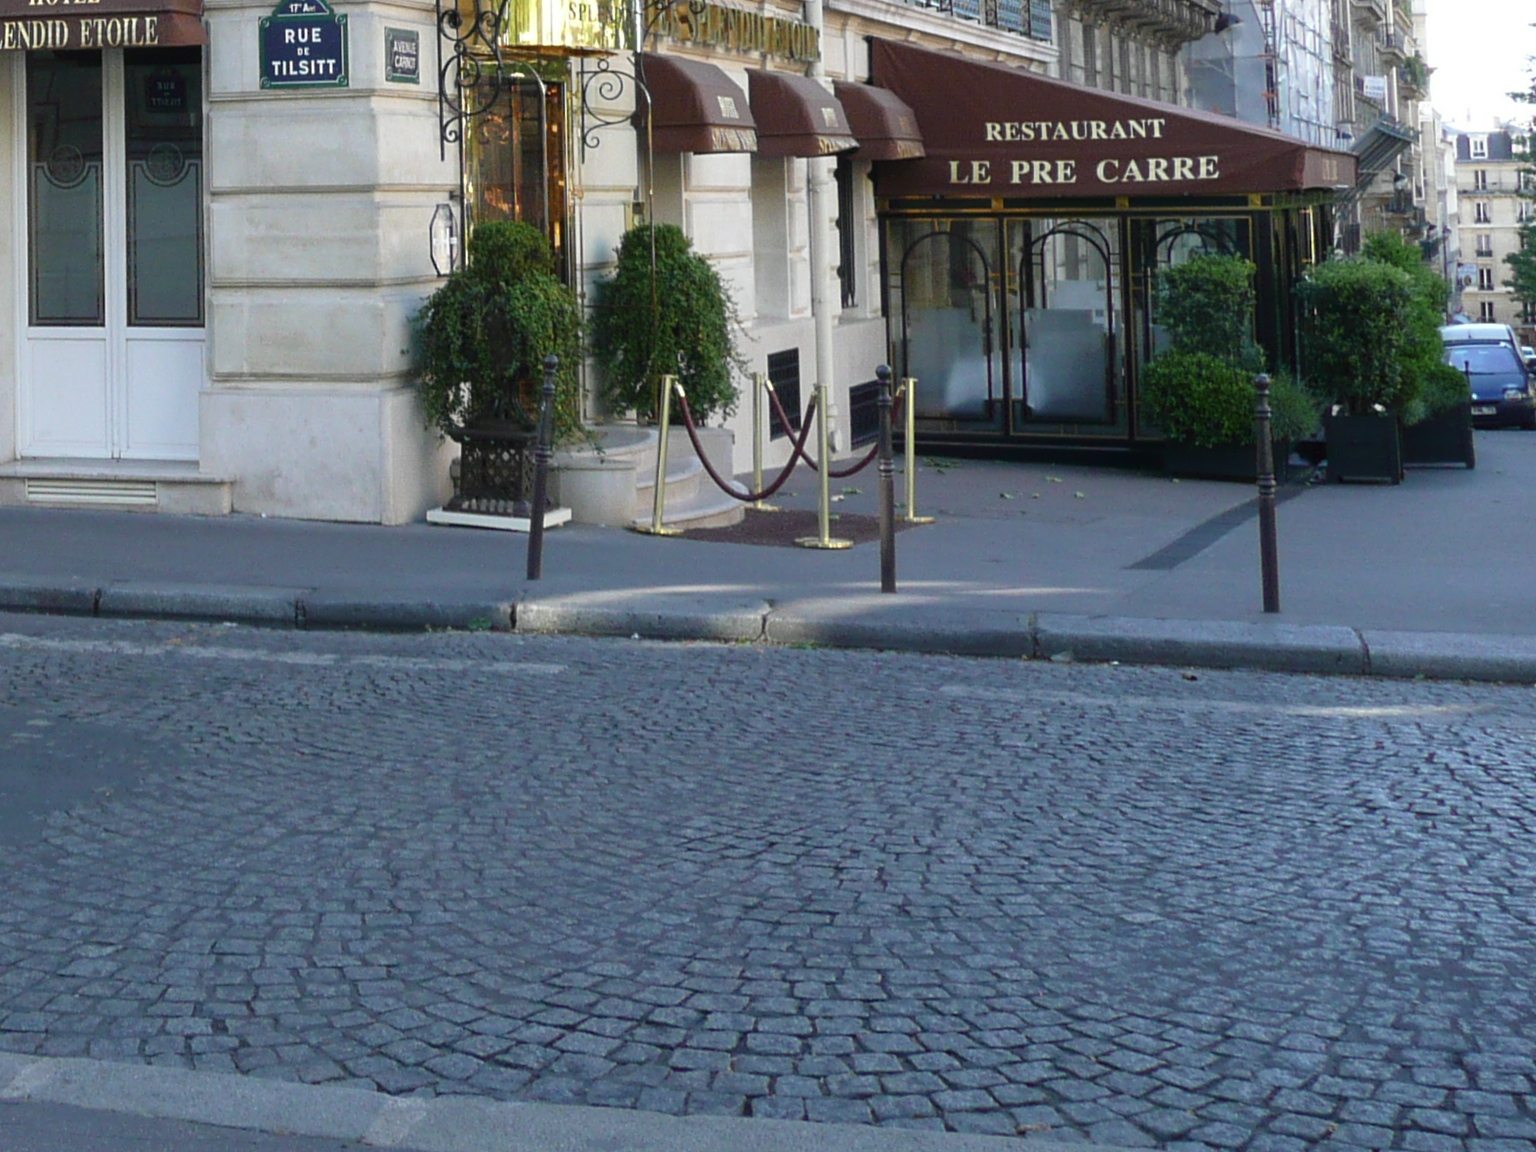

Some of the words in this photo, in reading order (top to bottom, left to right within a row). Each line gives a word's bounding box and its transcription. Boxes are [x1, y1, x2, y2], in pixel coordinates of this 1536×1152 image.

[80, 17, 158, 47] ETOILE
[284, 27, 322, 44] RUE
[297, 47, 310, 56] DE
[393, 40, 417, 55] AVENUE
[271, 59, 336, 76] TILSITT
[394, 54, 416, 70] CARNOT
[984, 118, 1166, 142] RESTAURANT
[948, 161, 992, 184] LE
[1010, 160, 1077, 184] PRE
[1096, 155, 1221, 183] CARRE
